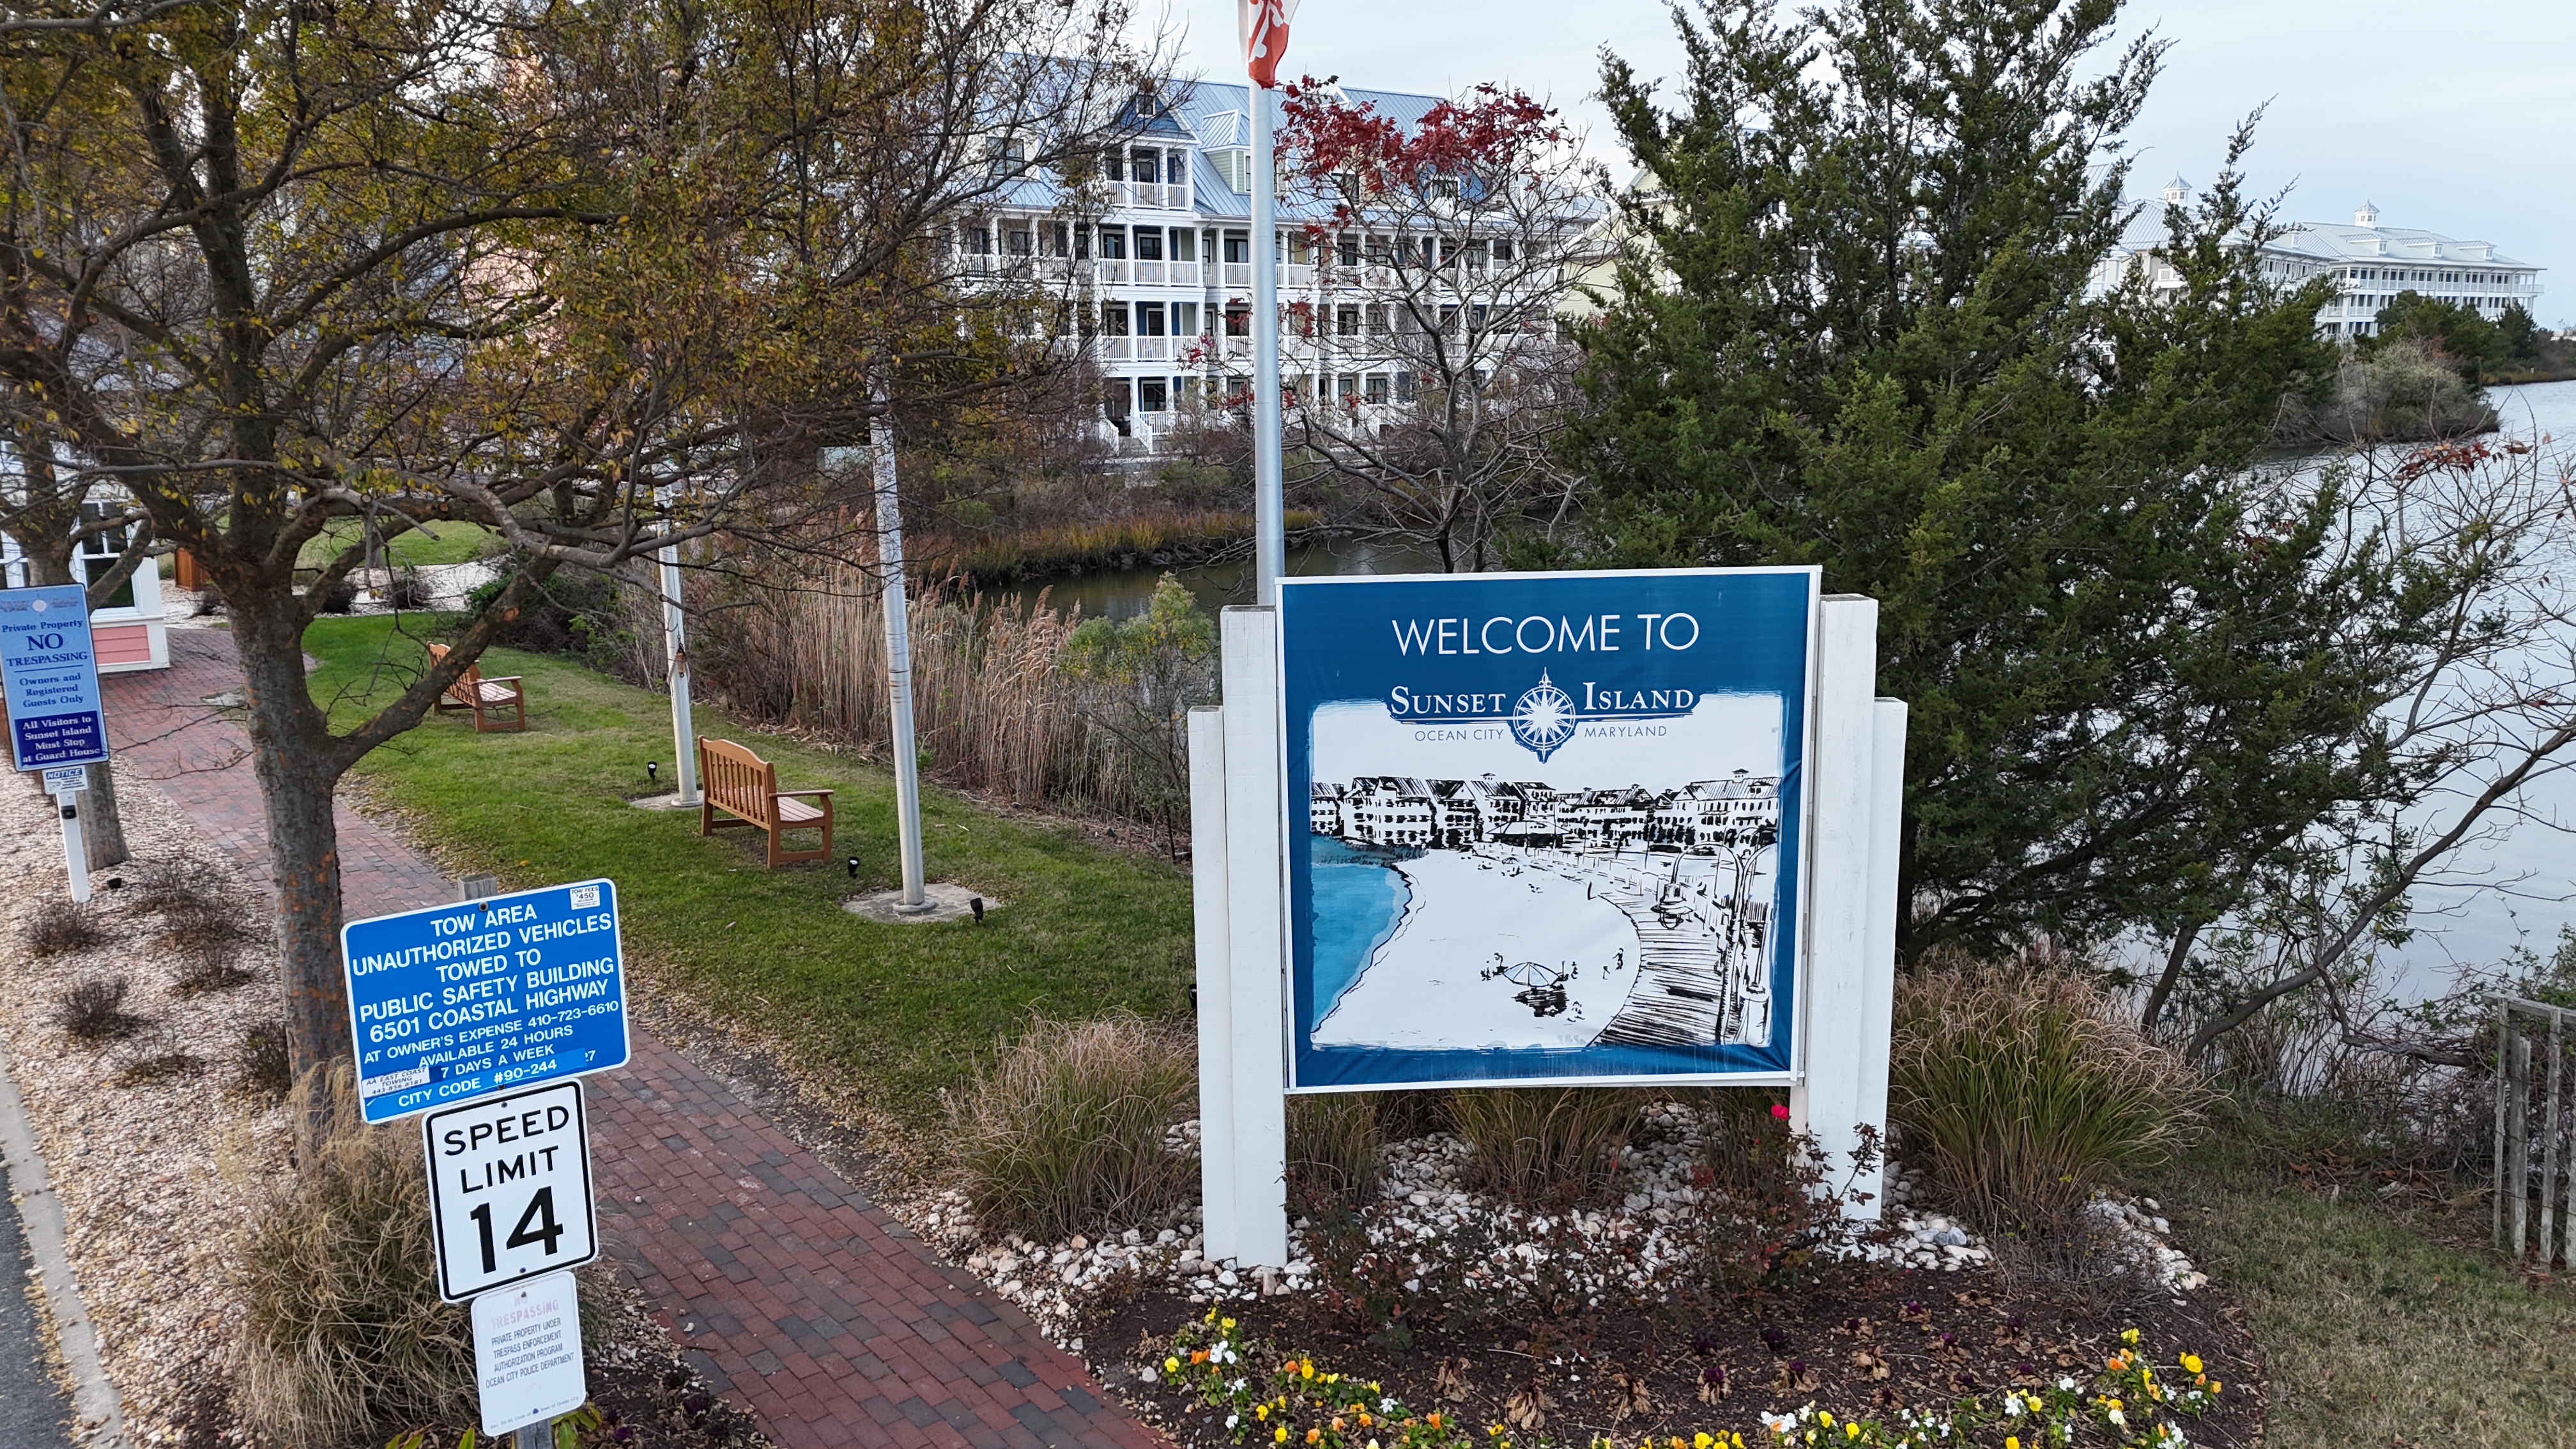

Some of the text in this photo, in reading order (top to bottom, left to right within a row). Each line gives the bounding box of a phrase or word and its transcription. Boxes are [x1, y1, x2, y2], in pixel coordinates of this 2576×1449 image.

[2, 620, 83, 632] Private Property
[1391, 612, 1699, 657] WELCOME TO
[26, 632, 63, 651] NO
[6, 651, 88, 666] TRESPASSING
[19, 672, 81, 686] Owners and
[26, 684, 79, 696] Registered
[23, 694, 84, 708] Guests Only
[22, 721, 38, 730] All
[41, 718, 79, 727] Visitors
[25, 726, 92, 740] Sunset Island
[1414, 726, 1667, 741] OCEAN CITY MARYLAND
[34, 739, 86, 750] Must Stop
[35, 751, 66, 761] Guard
[69, 748, 100, 757] House
[47, 769, 80, 779] NOTICE
[430, 903, 537, 937] TOW AREA
[352, 912, 612, 976] UNAUTHORIZED VEHICLES
[436, 948, 541, 983] TOWED TO
[360, 957, 614, 1023] PUBLIC SAFETY BUILDING
[369, 979, 608, 1043] 6501 COASTAL HIGHWAY
[364, 1000, 619, 1064] AT OWNER'S EXPENSE 410-723-6610
[419, 1025, 573, 1068] AVAILABLE 24 HOURS
[380, 1073, 399, 1082] EAST
[401, 1067, 426, 1077] COAST
[440, 1044, 555, 1078] 7 DAYS A WEEK
[382, 1076, 413, 1086] TOWING
[398, 1059, 557, 1107] CITY CODE #90-244
[444, 1105, 569, 1156] SPEED
[460, 1145, 558, 1194] LIMIT
[470, 1186, 564, 1274] 14
[514, 1292, 528, 1307] NO
[491, 1299, 560, 1330] TRESPASSING
[491, 1317, 561, 1346] PRIVATE PROPERTY UNDER
[493, 1330, 562, 1359] TRESPASS ENFORCEMENT
[486, 1352, 574, 1388] OCEAN CITY POLICE DEPARTMENT
[494, 1342, 563, 1372] AUTHORIZATION PROGRAM
